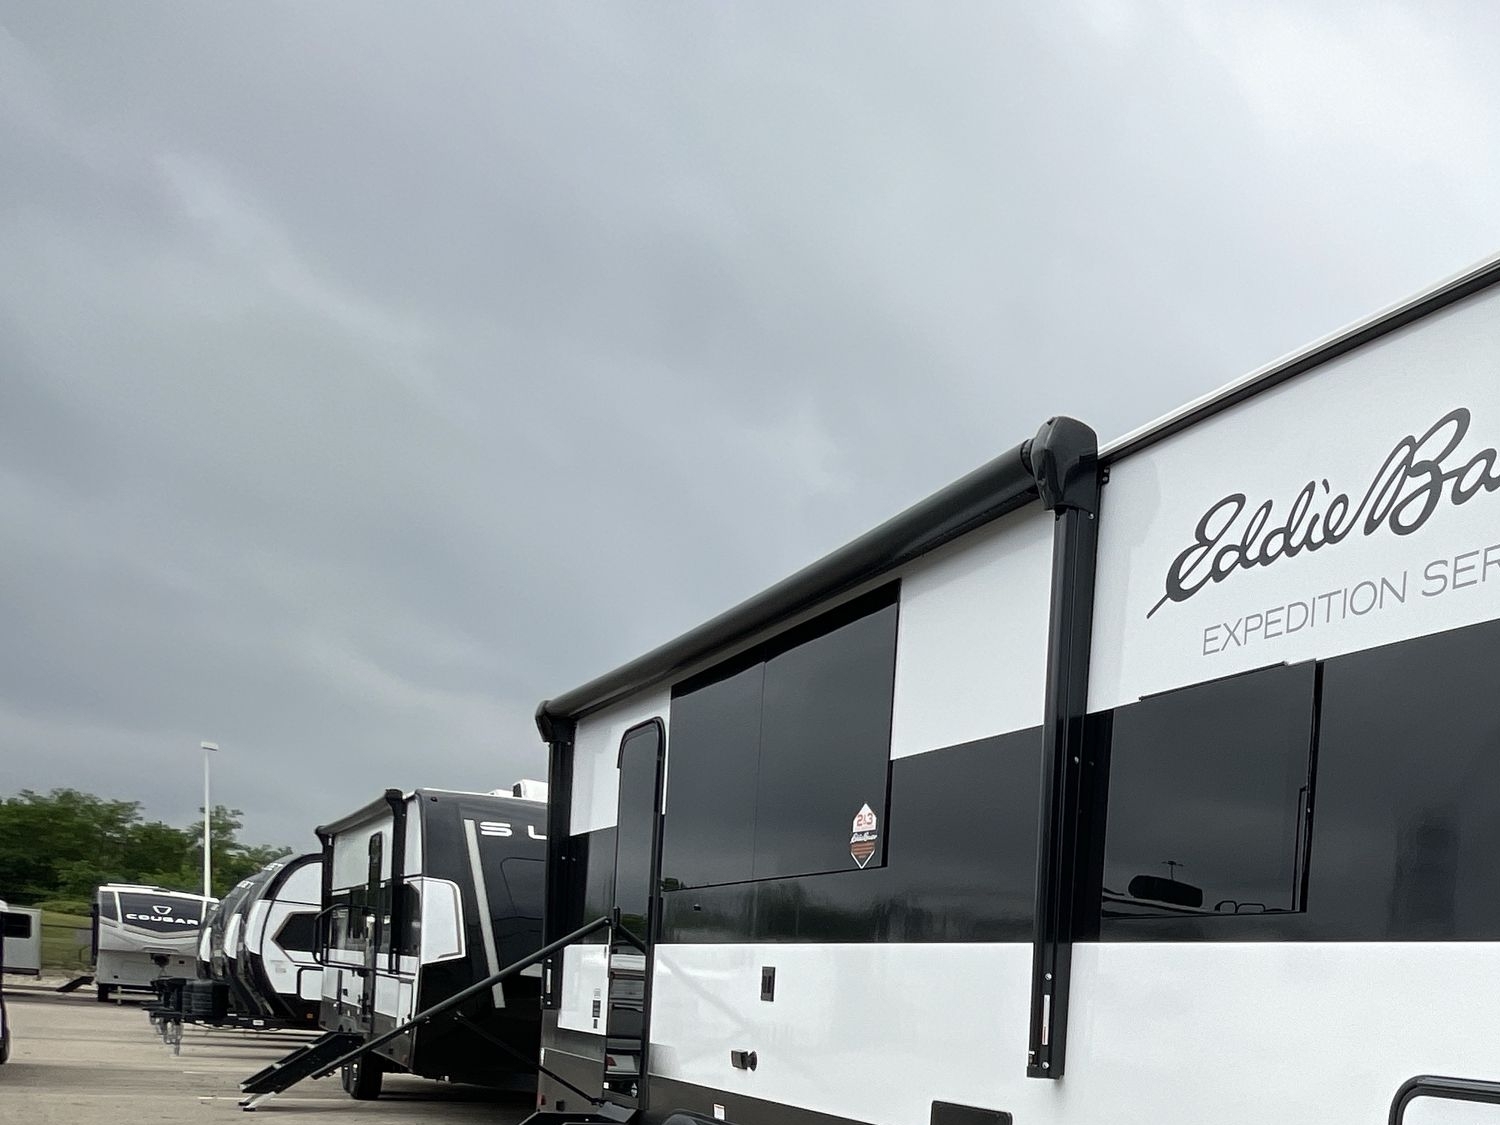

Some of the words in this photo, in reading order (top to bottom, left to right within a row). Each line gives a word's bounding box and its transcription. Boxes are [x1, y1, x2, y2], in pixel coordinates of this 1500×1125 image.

[1146, 478, 1358, 619] Eddie
[1202, 569, 1408, 656] EXPEDITION
[125, 913, 199, 926] COUGAR
